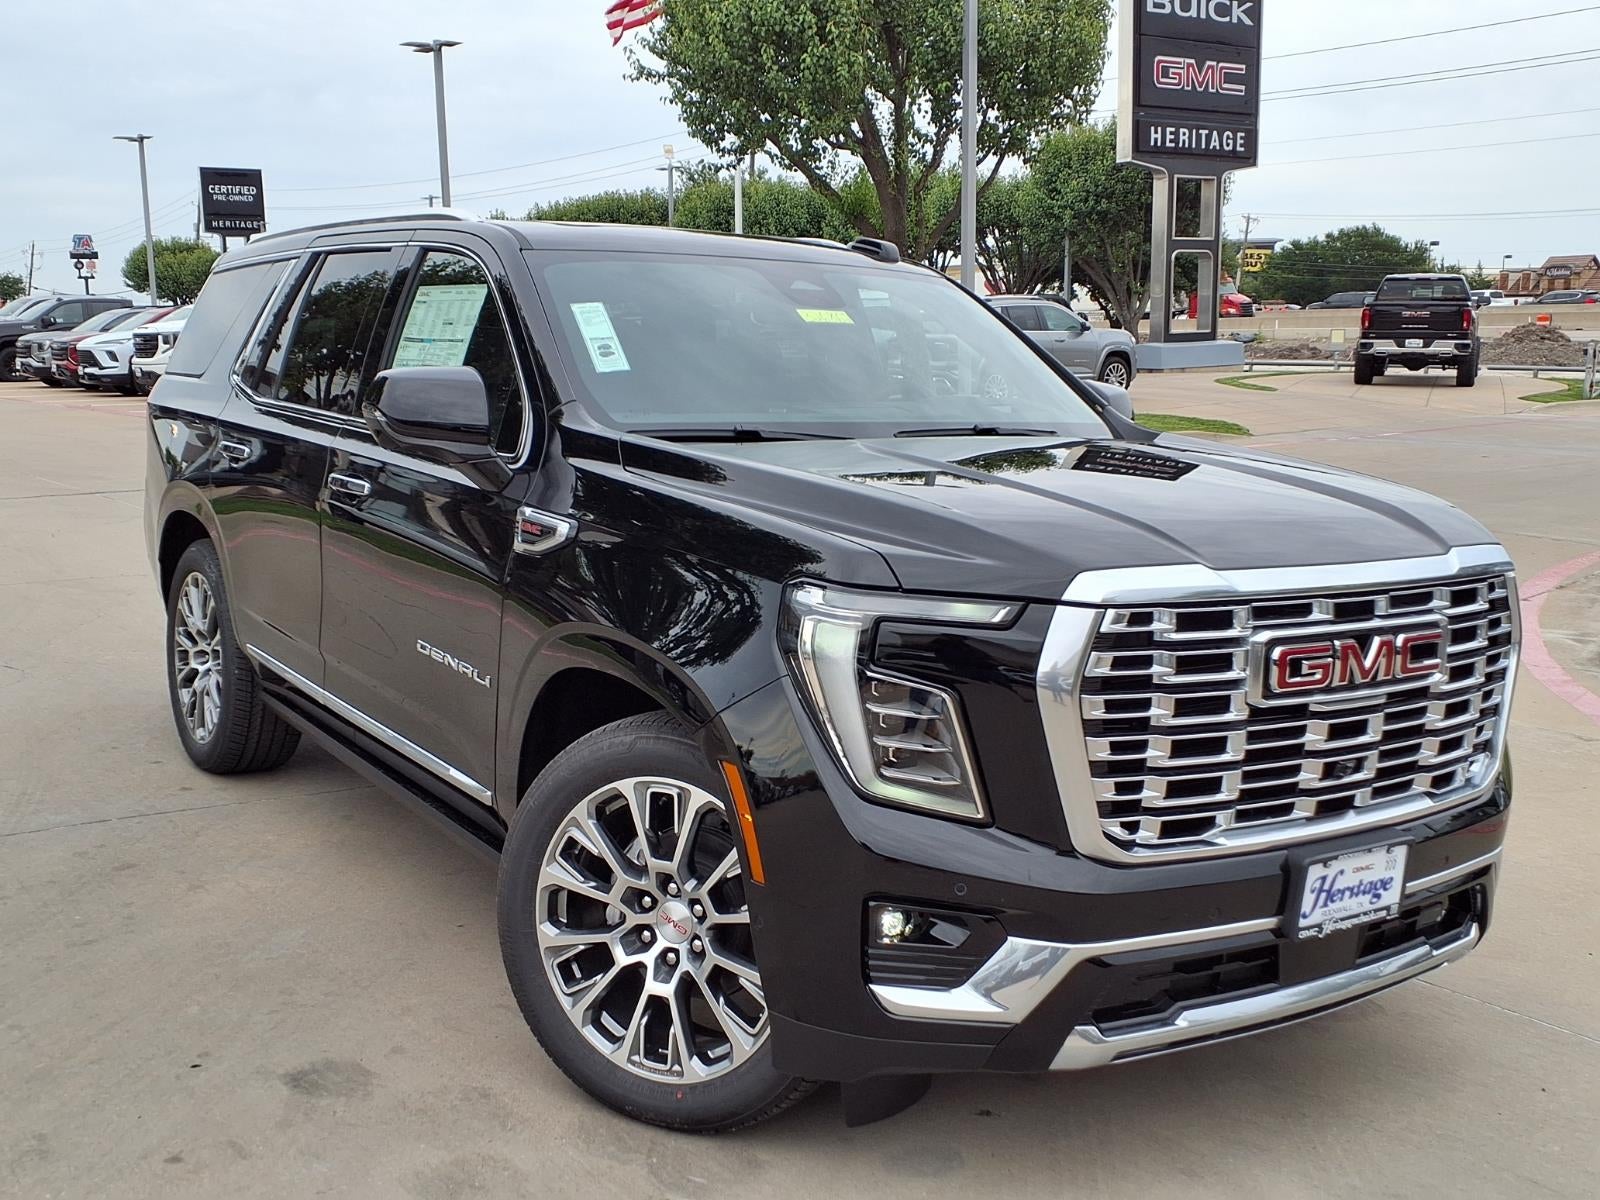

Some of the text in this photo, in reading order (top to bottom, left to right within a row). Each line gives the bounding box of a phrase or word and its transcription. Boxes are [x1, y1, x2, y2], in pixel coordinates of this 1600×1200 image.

[1146, 0, 1254, 26] BUICK
[1154, 55, 1246, 96] GMC
[1150, 125, 1245, 151] HERITAGE
[208, 184, 257, 195] CERTIFIED
[213, 194, 253, 202] PRE-OWNED
[212, 220, 259, 229] HERITAGE
[416, 639, 492, 689] DENALI
[1270, 629, 1444, 693] GMC
[1352, 863, 1375, 873] GMC
[1300, 868, 1395, 920] Heritage
[660, 910, 688, 936] GMC
